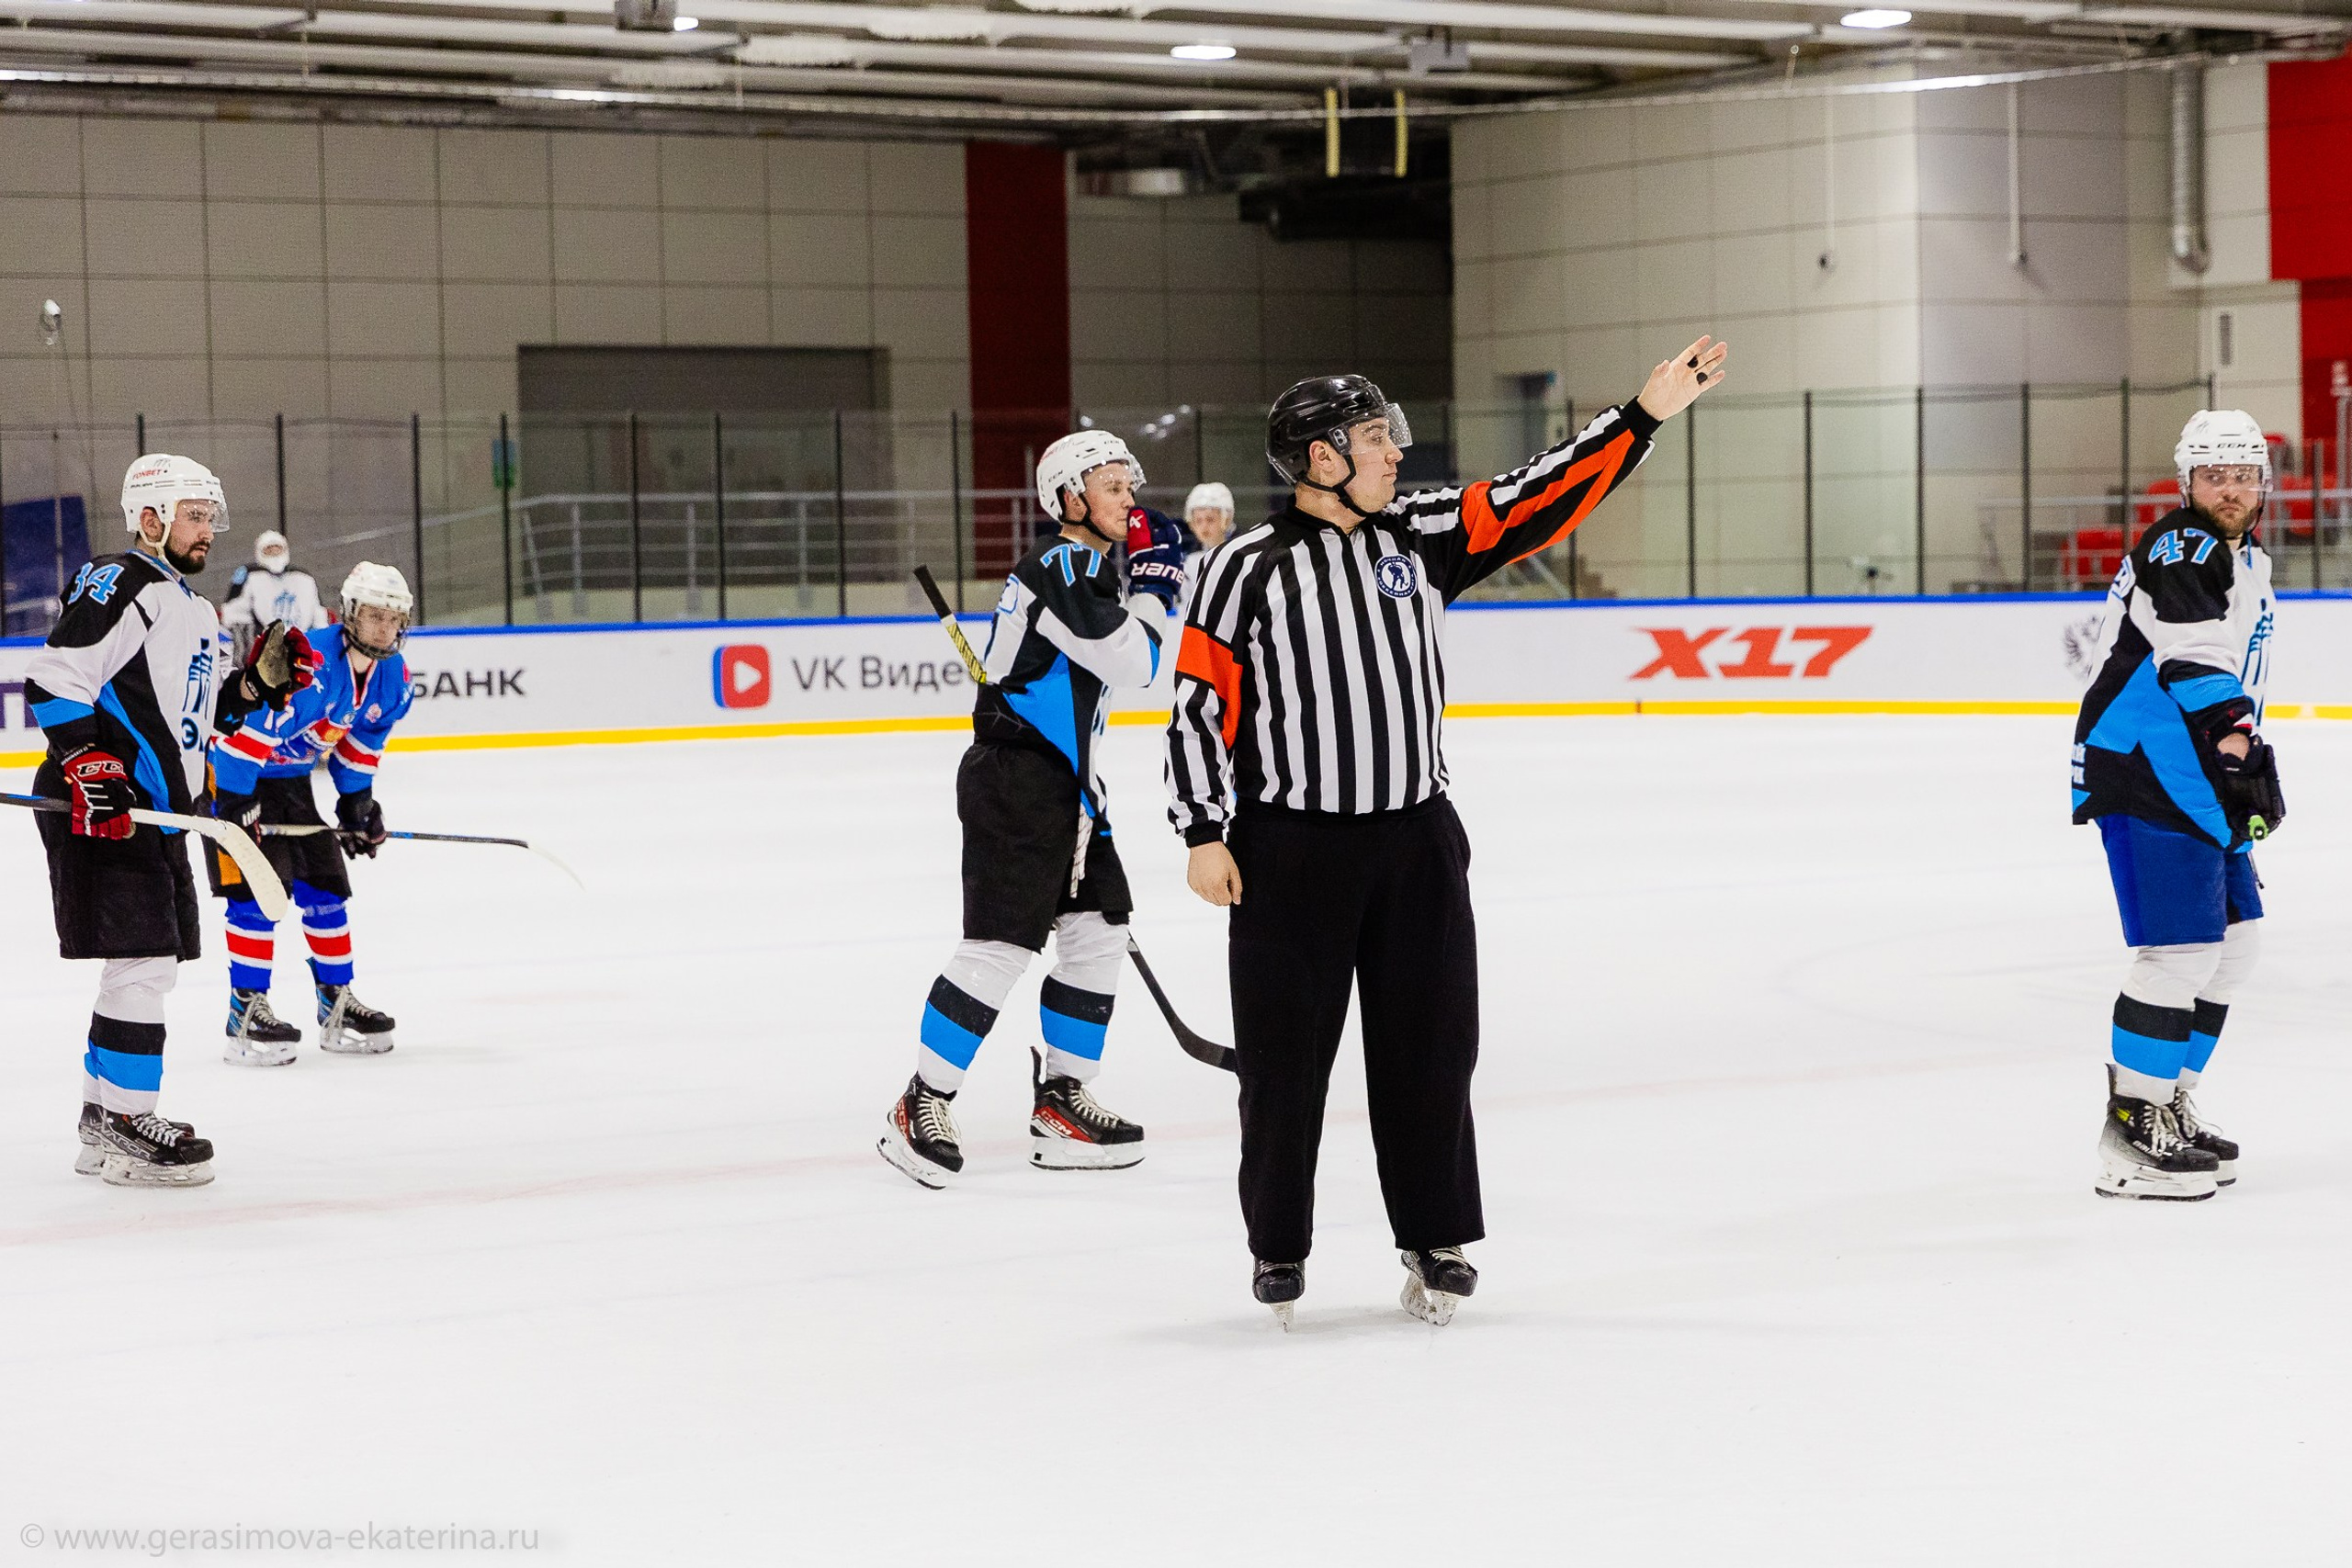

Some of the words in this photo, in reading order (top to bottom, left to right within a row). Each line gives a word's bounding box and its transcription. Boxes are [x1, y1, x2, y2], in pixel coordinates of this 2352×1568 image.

[2148, 526, 2219, 566] 47
[1039, 543, 1102, 587] 77
[1130, 562, 1185, 585] AUER
[791, 657, 846, 690] VK
[860, 654, 975, 694] Виде
[76, 760, 127, 777] CC
[1040, 1111, 1073, 1136] CCM
